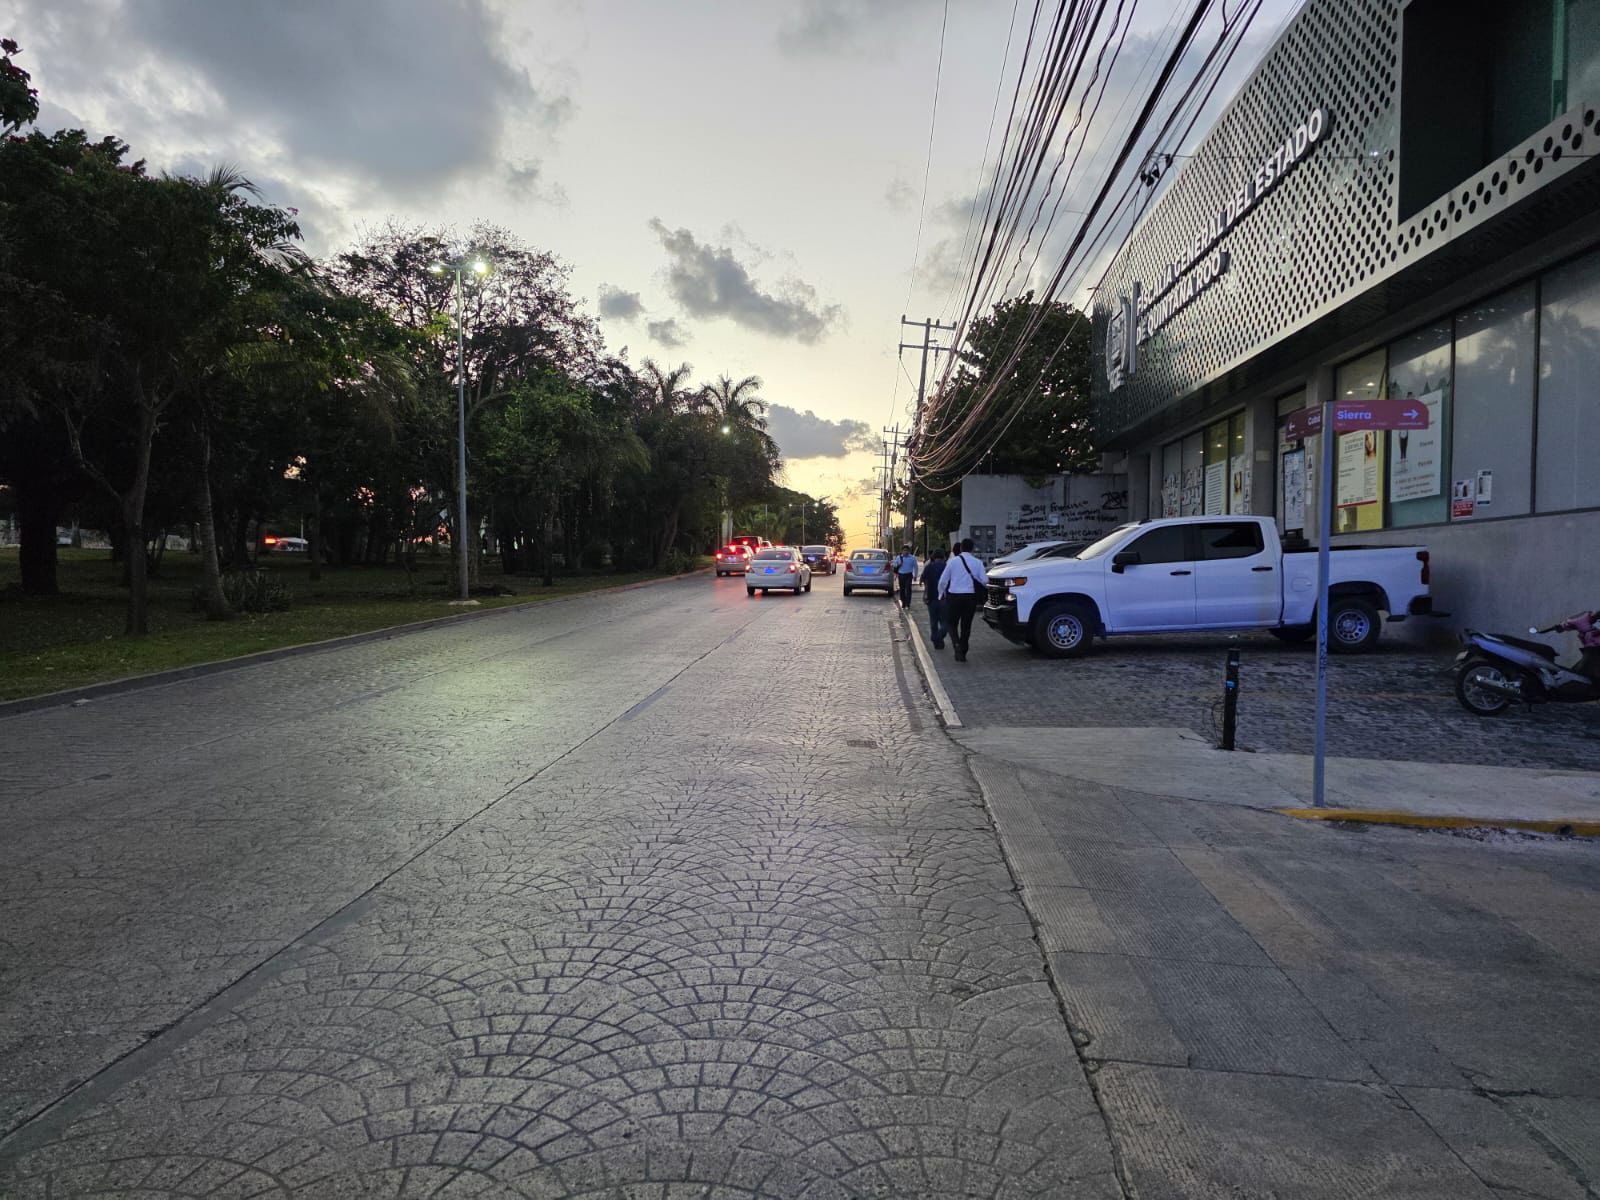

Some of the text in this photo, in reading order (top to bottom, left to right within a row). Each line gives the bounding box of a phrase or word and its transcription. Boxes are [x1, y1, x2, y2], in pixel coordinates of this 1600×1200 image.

[1174, 211, 1224, 278] GENERAL
[1227, 182, 1252, 226] DEL
[1255, 108, 1323, 193] ESTADO
[1136, 252, 1222, 346] DE QUINTANA ROO
[1337, 409, 1372, 420] Sierra
